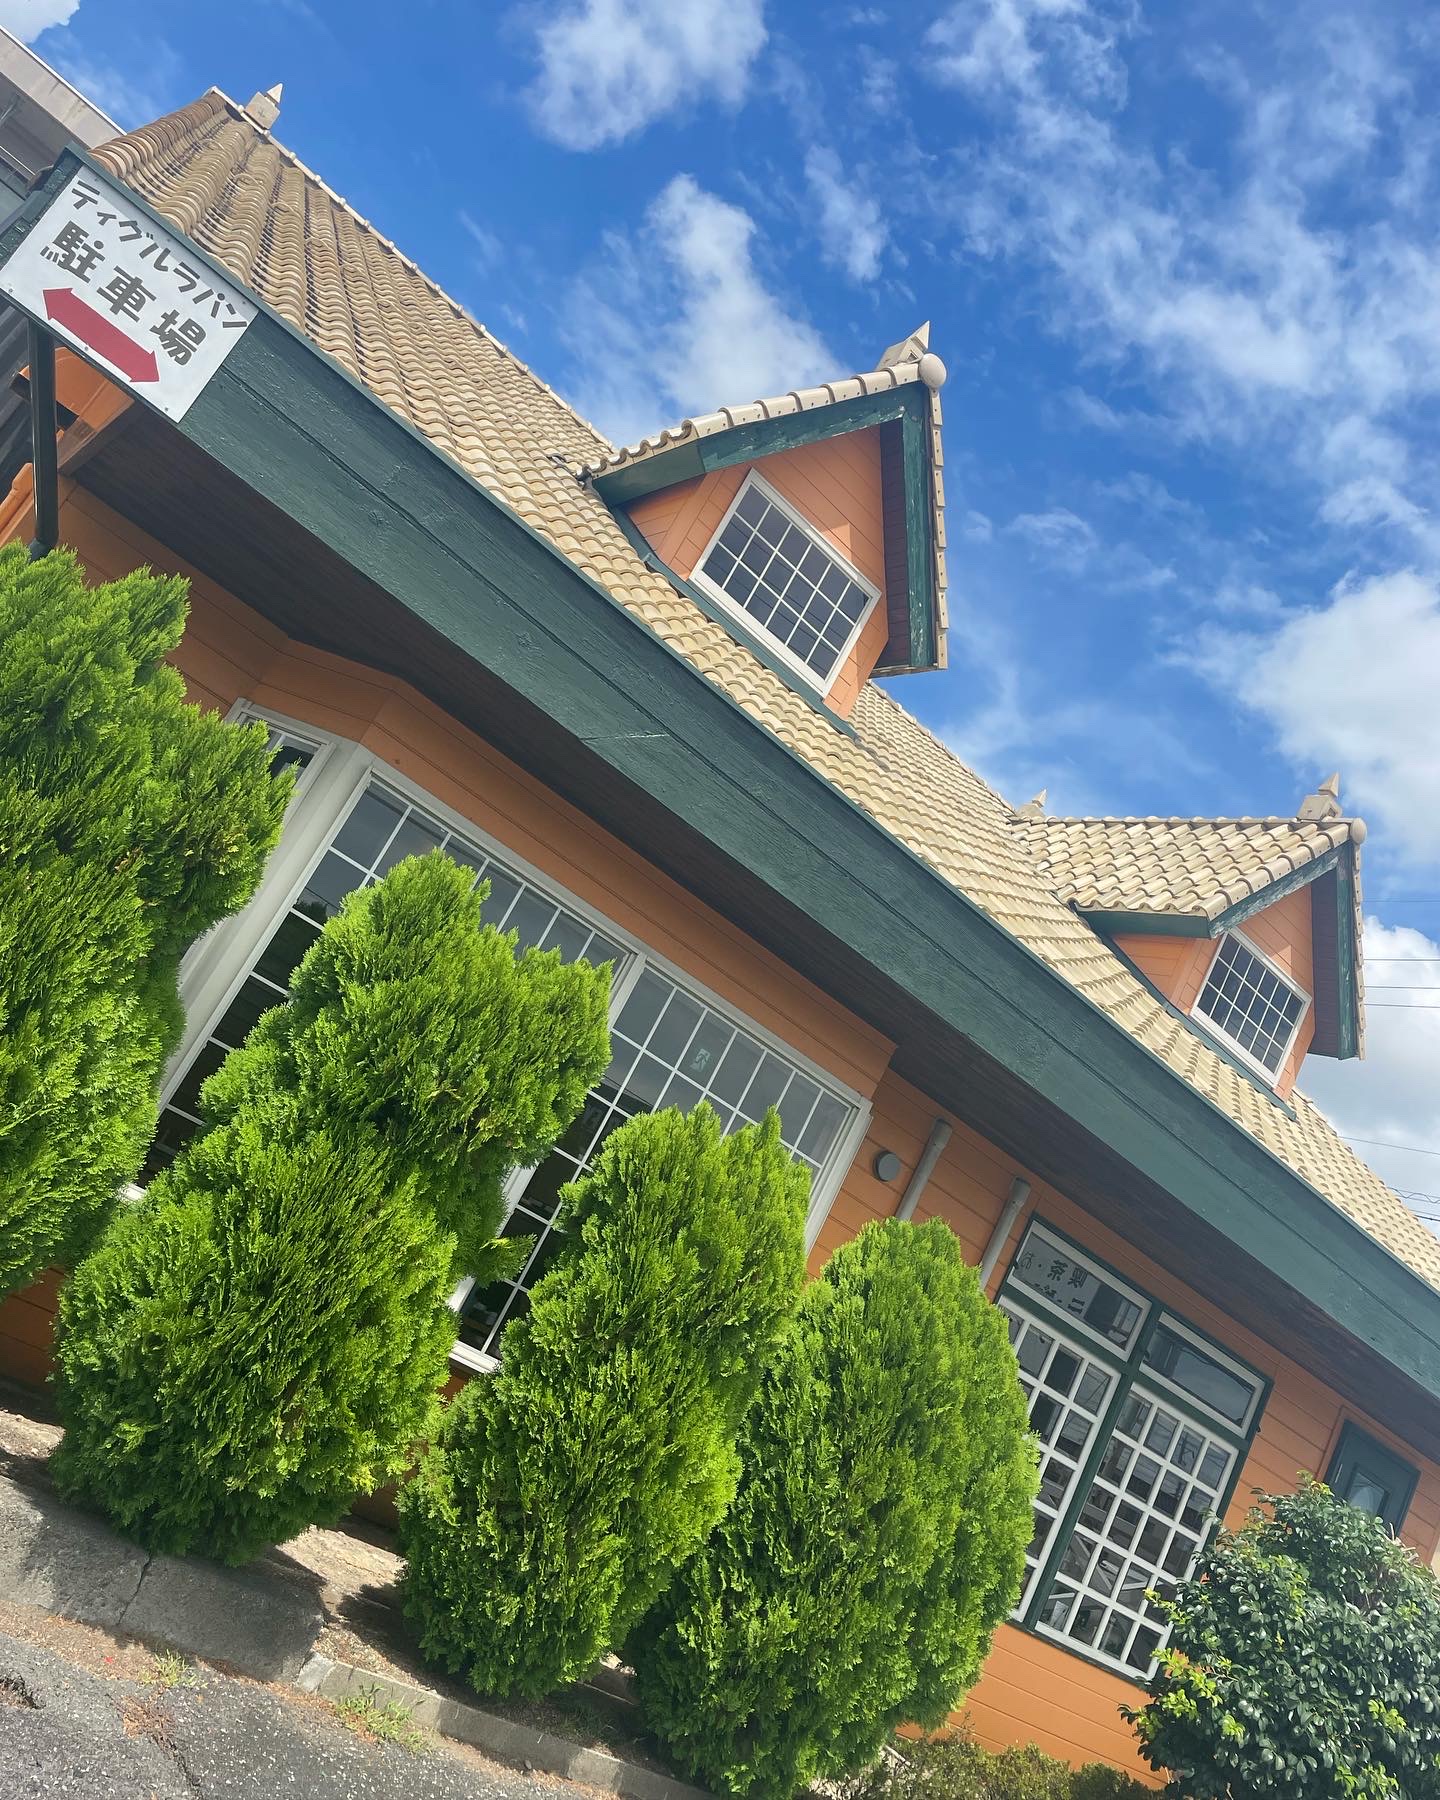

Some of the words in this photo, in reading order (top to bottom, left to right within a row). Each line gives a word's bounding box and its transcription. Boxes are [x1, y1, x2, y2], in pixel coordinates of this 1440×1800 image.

[40, 220, 207, 366] 駐車場
[71, 180, 247, 328] ティグルラパン
